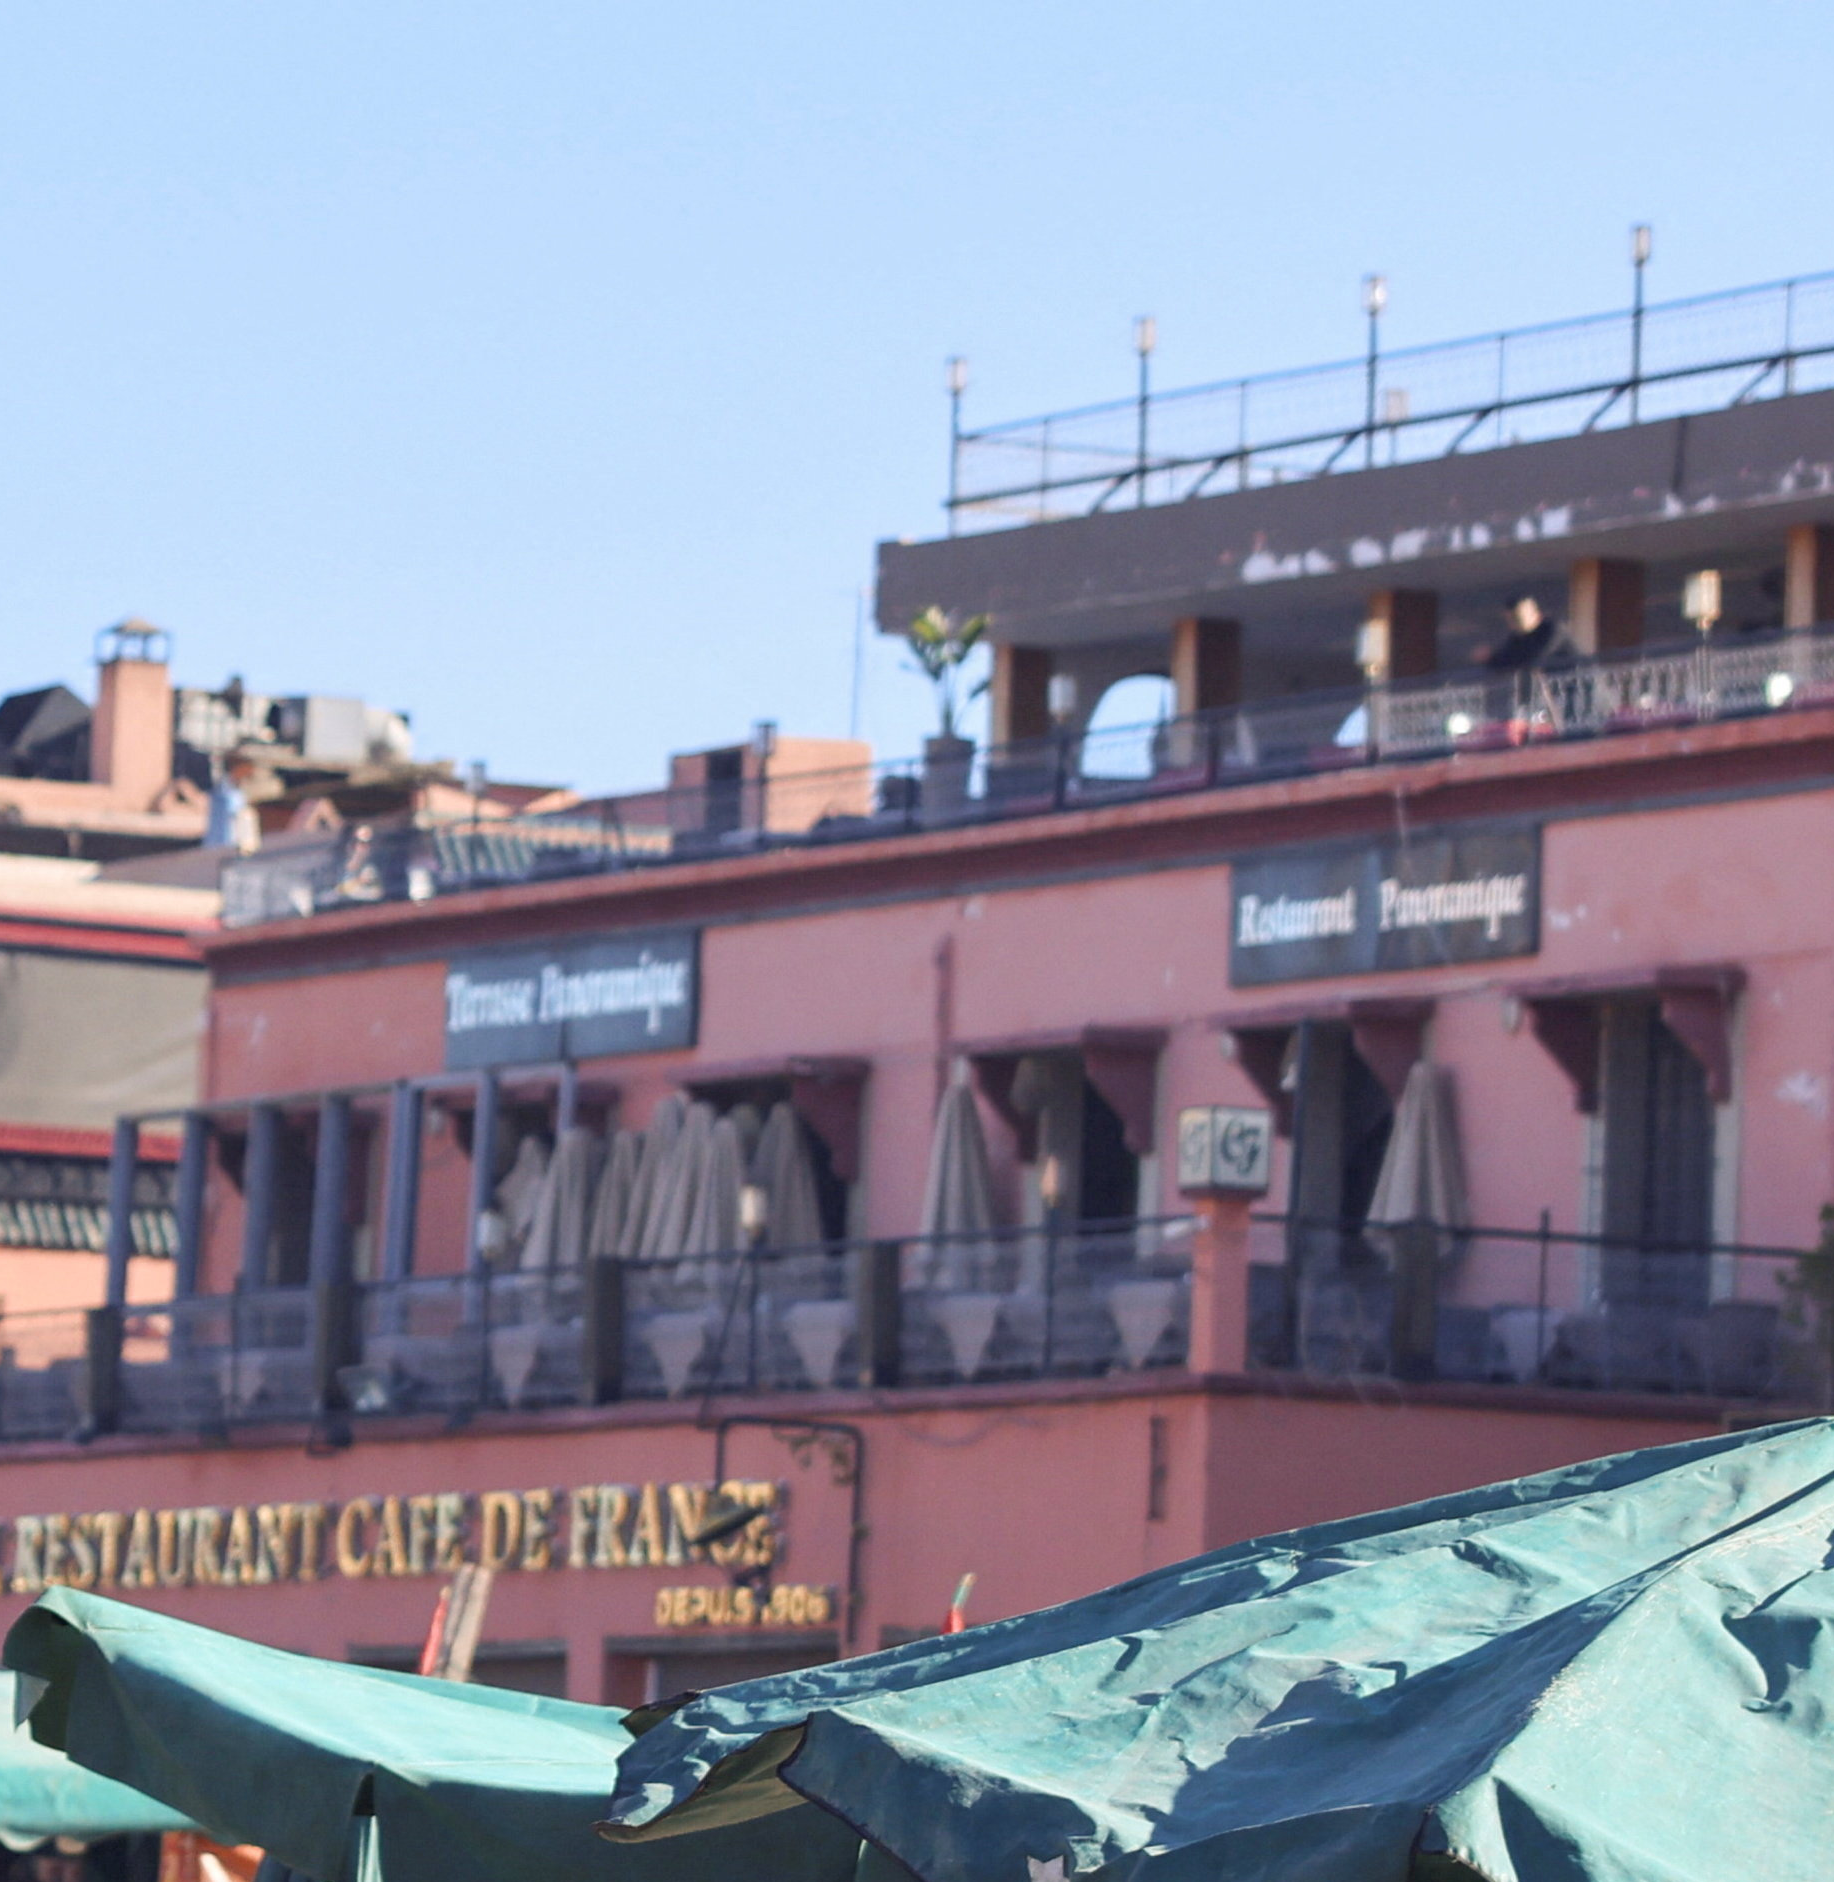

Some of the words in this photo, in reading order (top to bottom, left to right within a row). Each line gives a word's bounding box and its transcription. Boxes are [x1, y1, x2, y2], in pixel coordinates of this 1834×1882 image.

[1237, 886, 1356, 947] Restaurant
[1378, 872, 1526, 941] Panoramique
[11, 1502, 327, 1594] RESTAURANT
[335, 1491, 466, 1577] CAFE
[480, 1487, 554, 1571] DE
[570, 1480, 776, 1569] FRANCE
